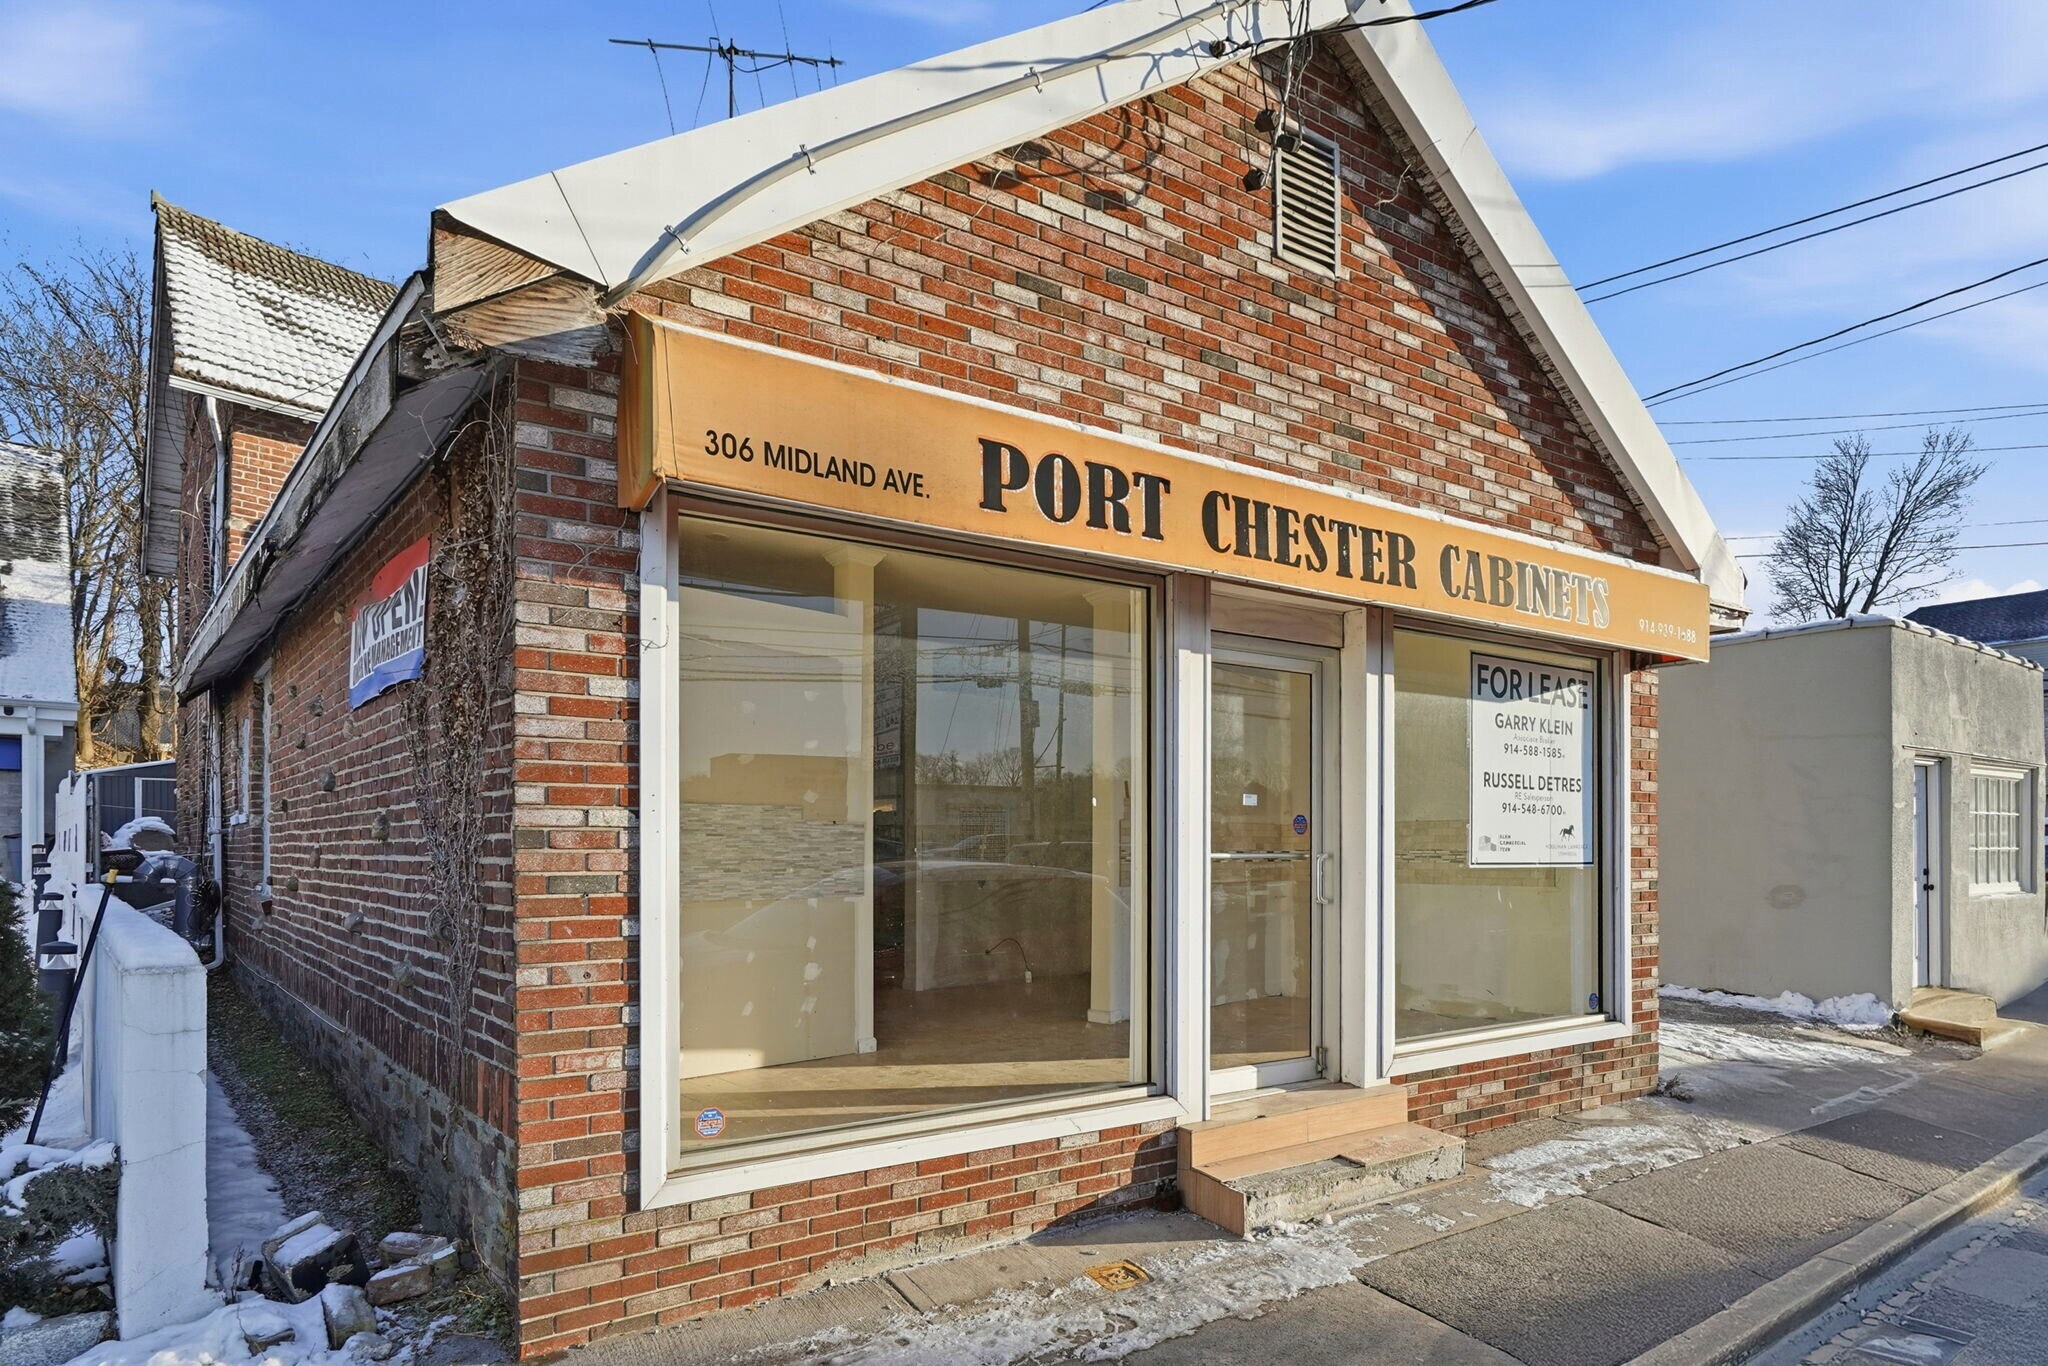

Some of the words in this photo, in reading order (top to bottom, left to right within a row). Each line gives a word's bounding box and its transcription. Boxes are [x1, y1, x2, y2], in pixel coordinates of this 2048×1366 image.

[704, 429, 755, 463] 306
[763, 441, 876, 488] MIDLAND
[882, 467, 930, 499] AVE.
[978, 437, 1171, 542] PORT
[1201, 490, 1418, 590] CHESTER
[1439, 543, 1610, 629] CABINETS
[1477, 663, 1523, 701] FOR
[1528, 671, 1589, 710] LEASE
[1494, 713, 1537, 732] GARRY
[1539, 718, 1574, 736] KLEIN
[1483, 771, 1535, 791] RUSSELL
[1538, 775, 1582, 793] DETRES
